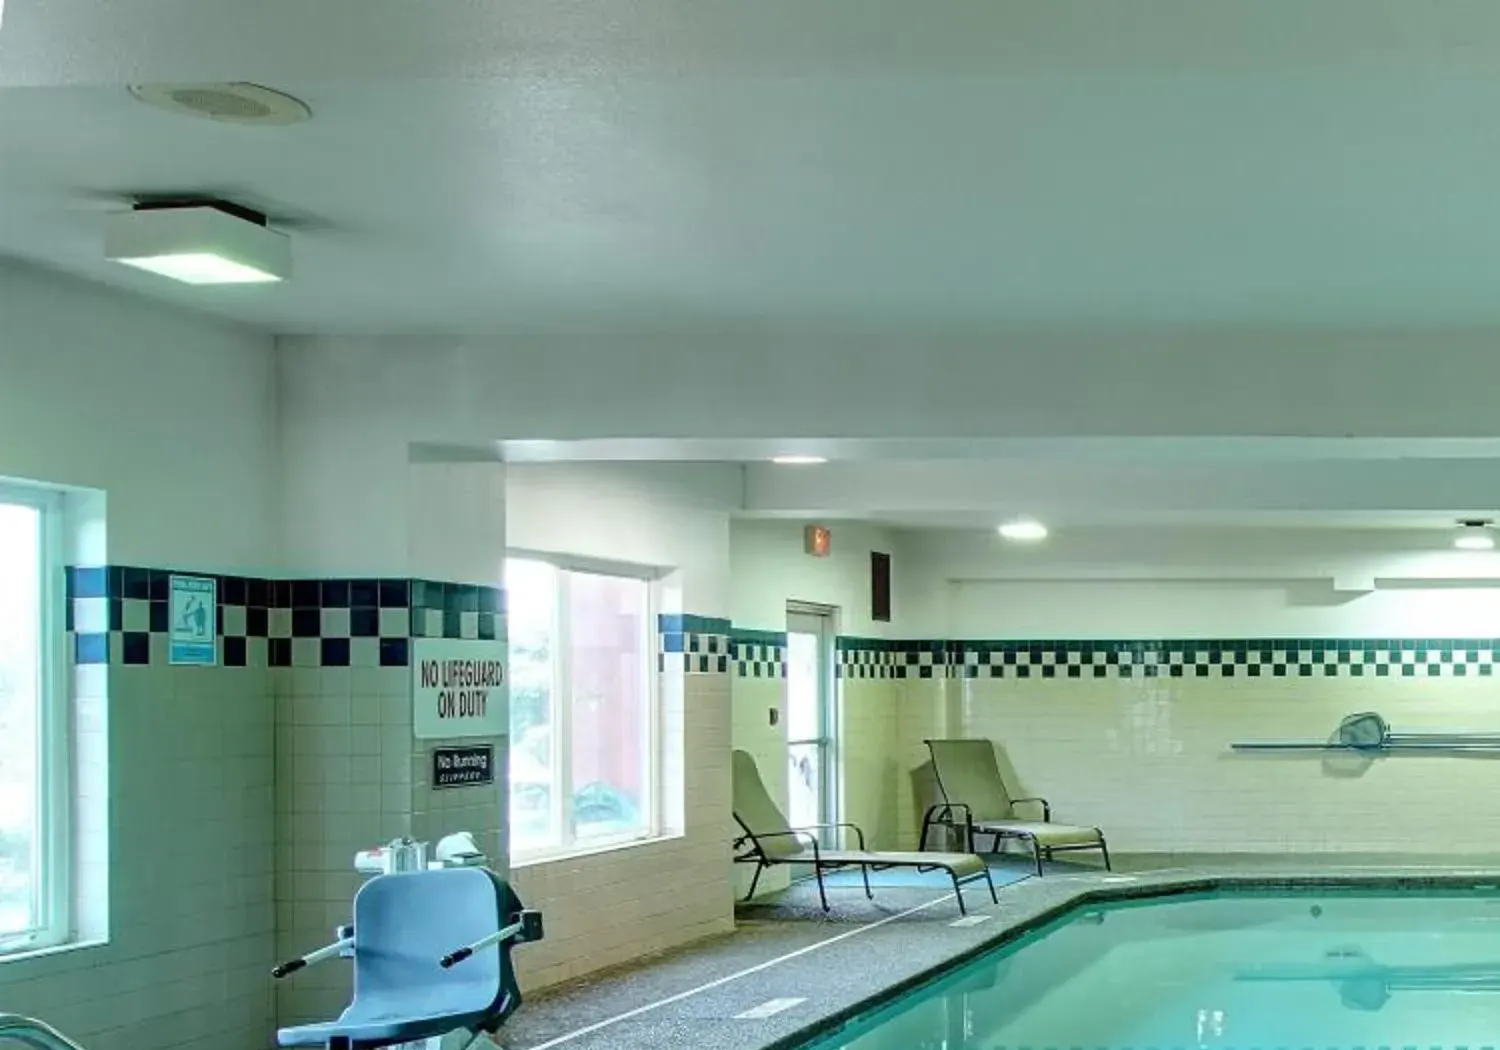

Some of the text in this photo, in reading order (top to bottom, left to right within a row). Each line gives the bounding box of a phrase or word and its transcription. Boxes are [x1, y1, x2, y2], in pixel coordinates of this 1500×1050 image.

[421, 659, 503, 688] NO LIFEGUARD
[438, 690, 488, 719] ON DUTY
[437, 752, 488, 769] No Running
